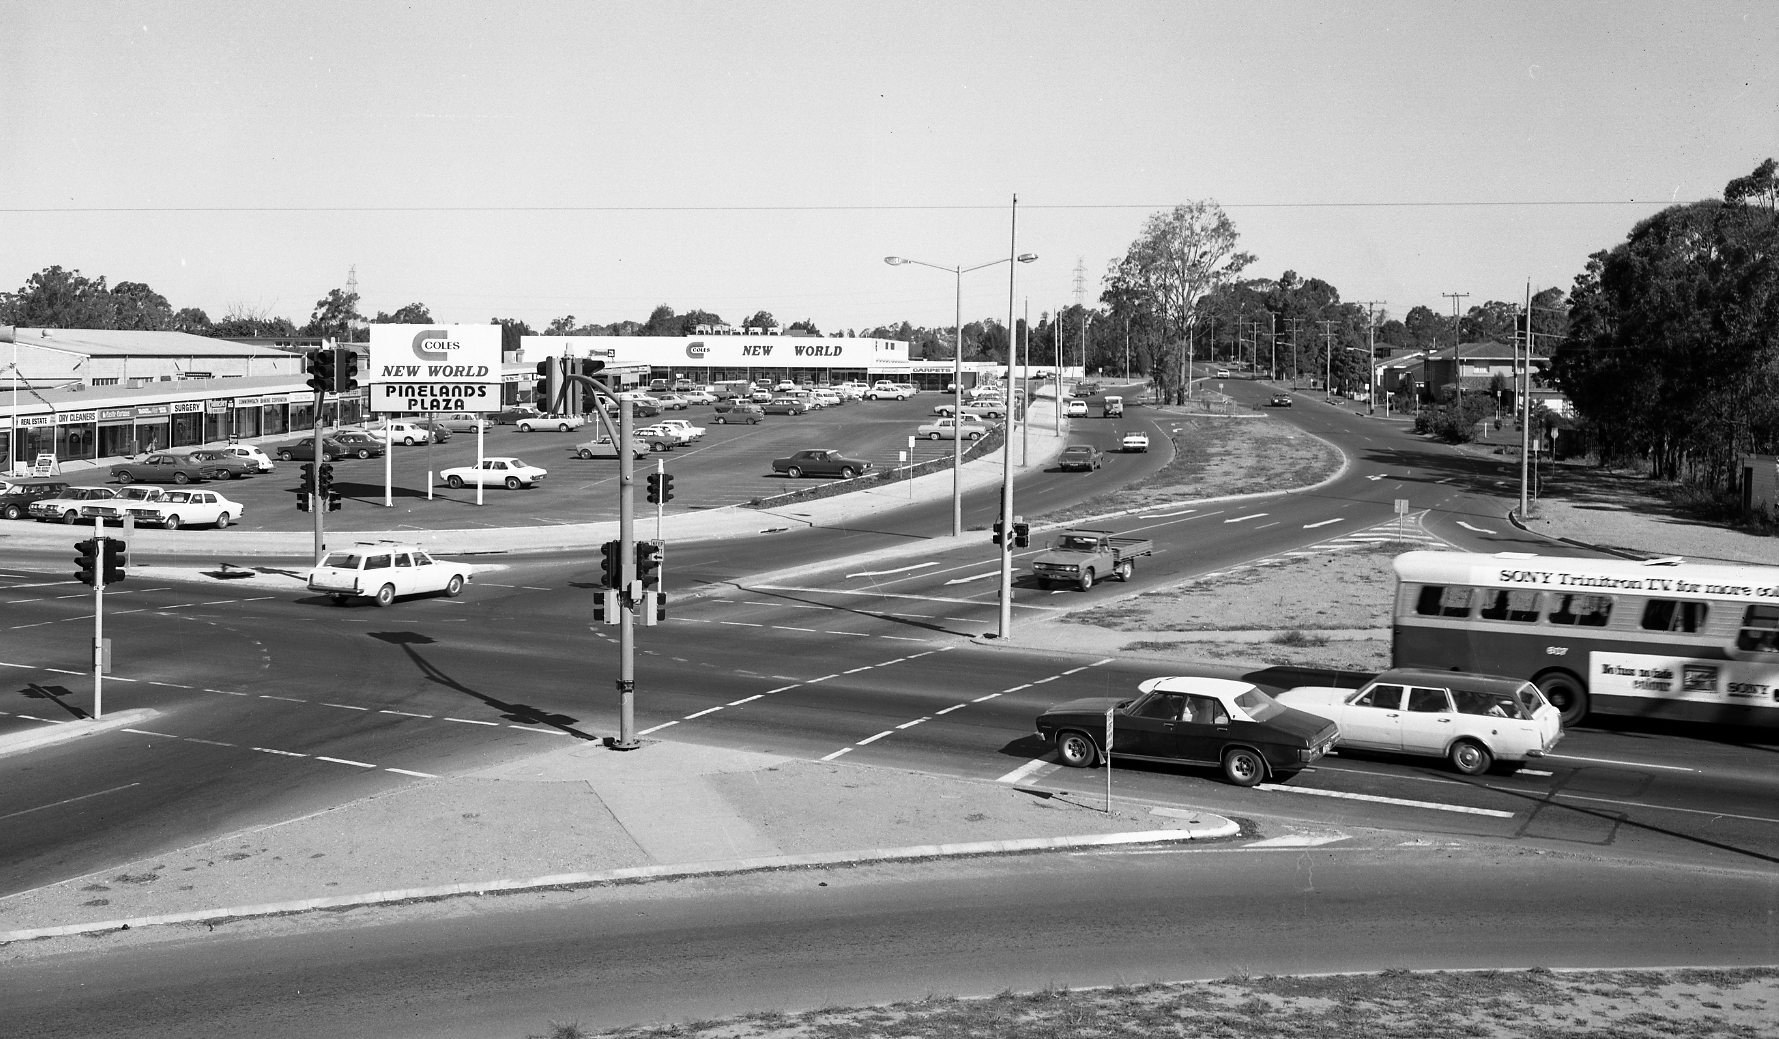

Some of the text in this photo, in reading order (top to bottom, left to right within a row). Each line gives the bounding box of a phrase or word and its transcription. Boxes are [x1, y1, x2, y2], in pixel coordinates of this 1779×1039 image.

[424, 341, 461, 350] COLES
[742, 345, 843, 357] NEW WORLD
[382, 365, 489, 377] NEW WORLD
[386, 385, 487, 398] PINELANDS
[174, 403, 200, 412] SURGERY
[408, 398, 465, 411] PLAZA
[21, 417, 47, 426] REAL ESTATE
[58, 414, 69, 422] DRY
[69, 412, 95, 422] CLEANERS
[1500, 569, 1553, 584] SONY
[1558, 572, 1642, 589] Trinitron
[1676, 579, 1701, 593] for
[1705, 584, 1752, 596] more
